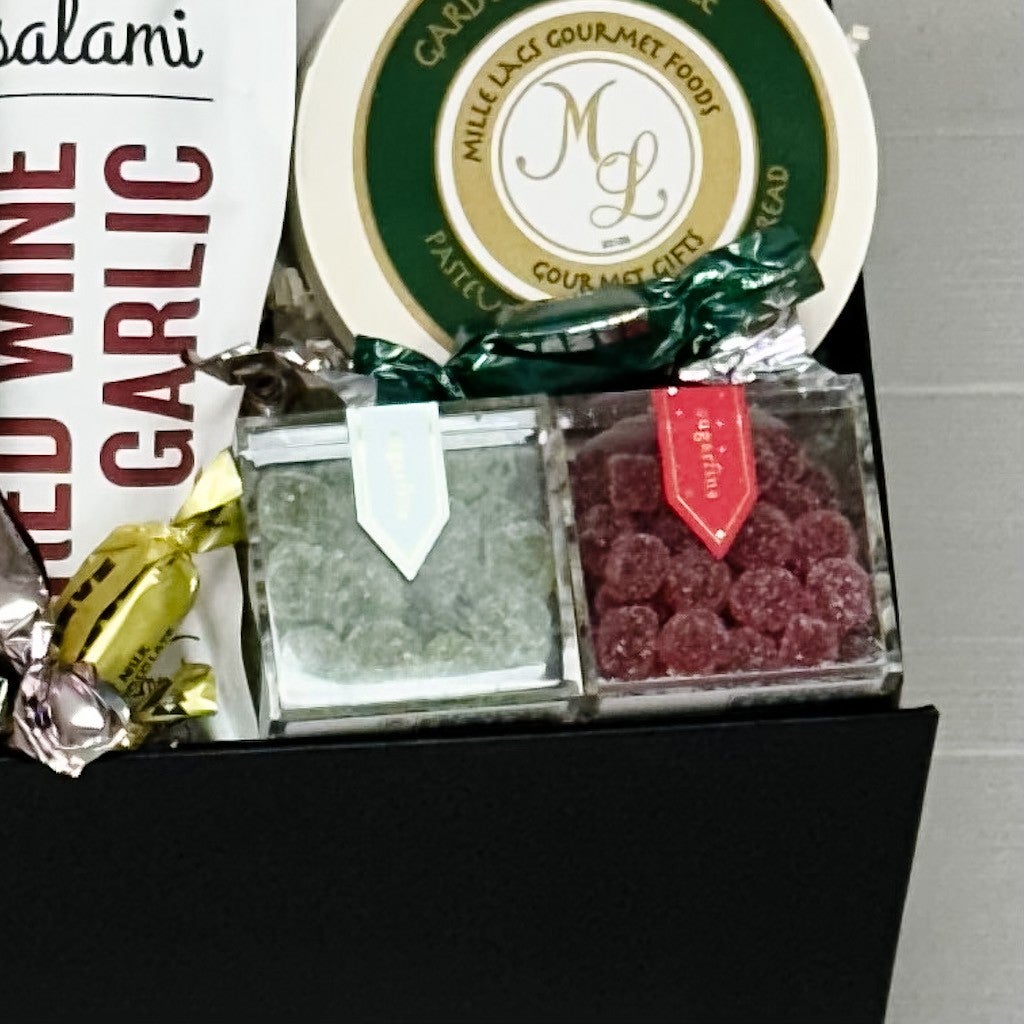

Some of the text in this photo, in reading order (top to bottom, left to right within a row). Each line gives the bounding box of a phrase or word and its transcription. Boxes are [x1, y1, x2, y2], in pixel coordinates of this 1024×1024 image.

[463, 21, 721, 163] MILLE LACS GOURMET FOODS
[100, 144, 214, 488] GARLIC
[652, 228, 705, 278] GIFTS
